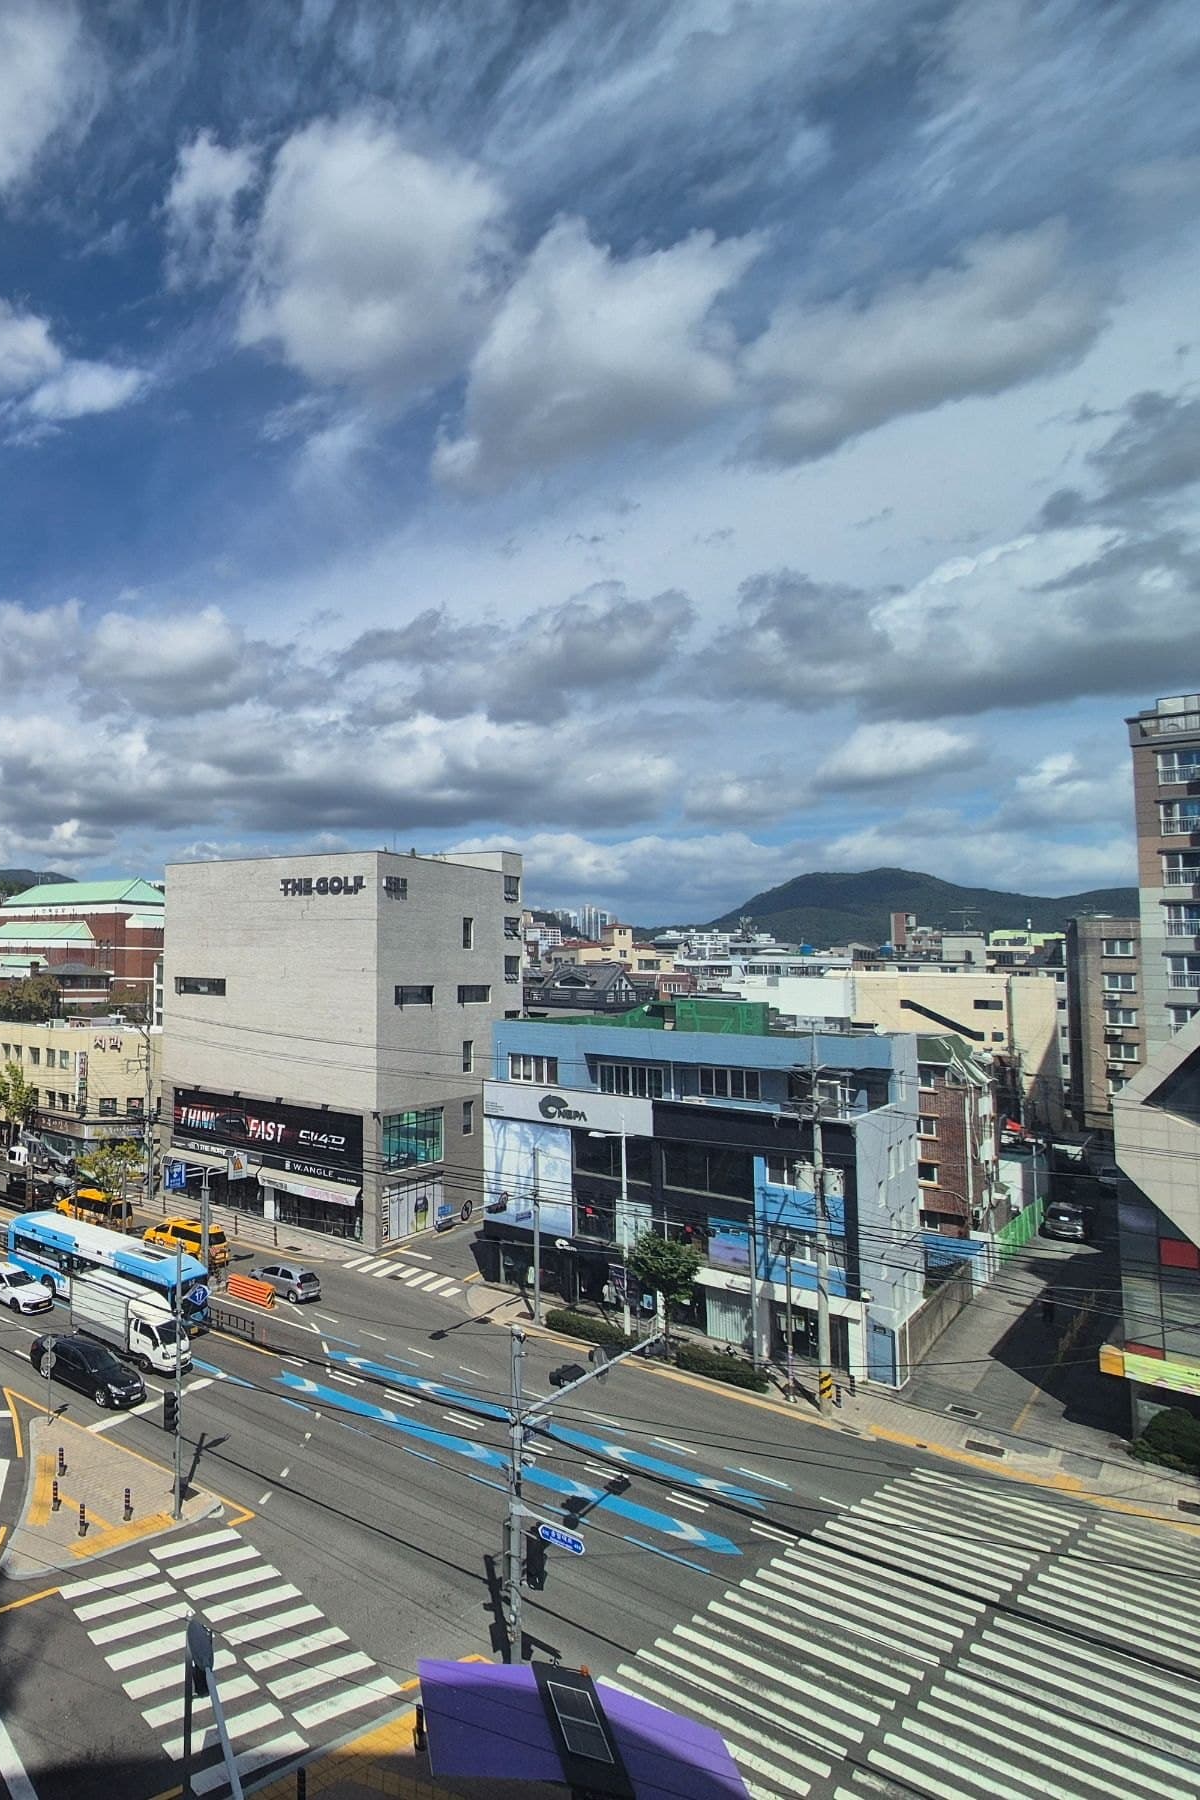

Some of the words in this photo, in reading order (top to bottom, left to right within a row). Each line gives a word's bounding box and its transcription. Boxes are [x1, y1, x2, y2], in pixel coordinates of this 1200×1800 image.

[280, 877, 313, 897] THE
[316, 875, 366, 896] GOLF
[93, 1035, 123, 1053] 치과
[248, 1118, 286, 1144] FAST
[293, 1162, 335, 1178] W.ANGLE
